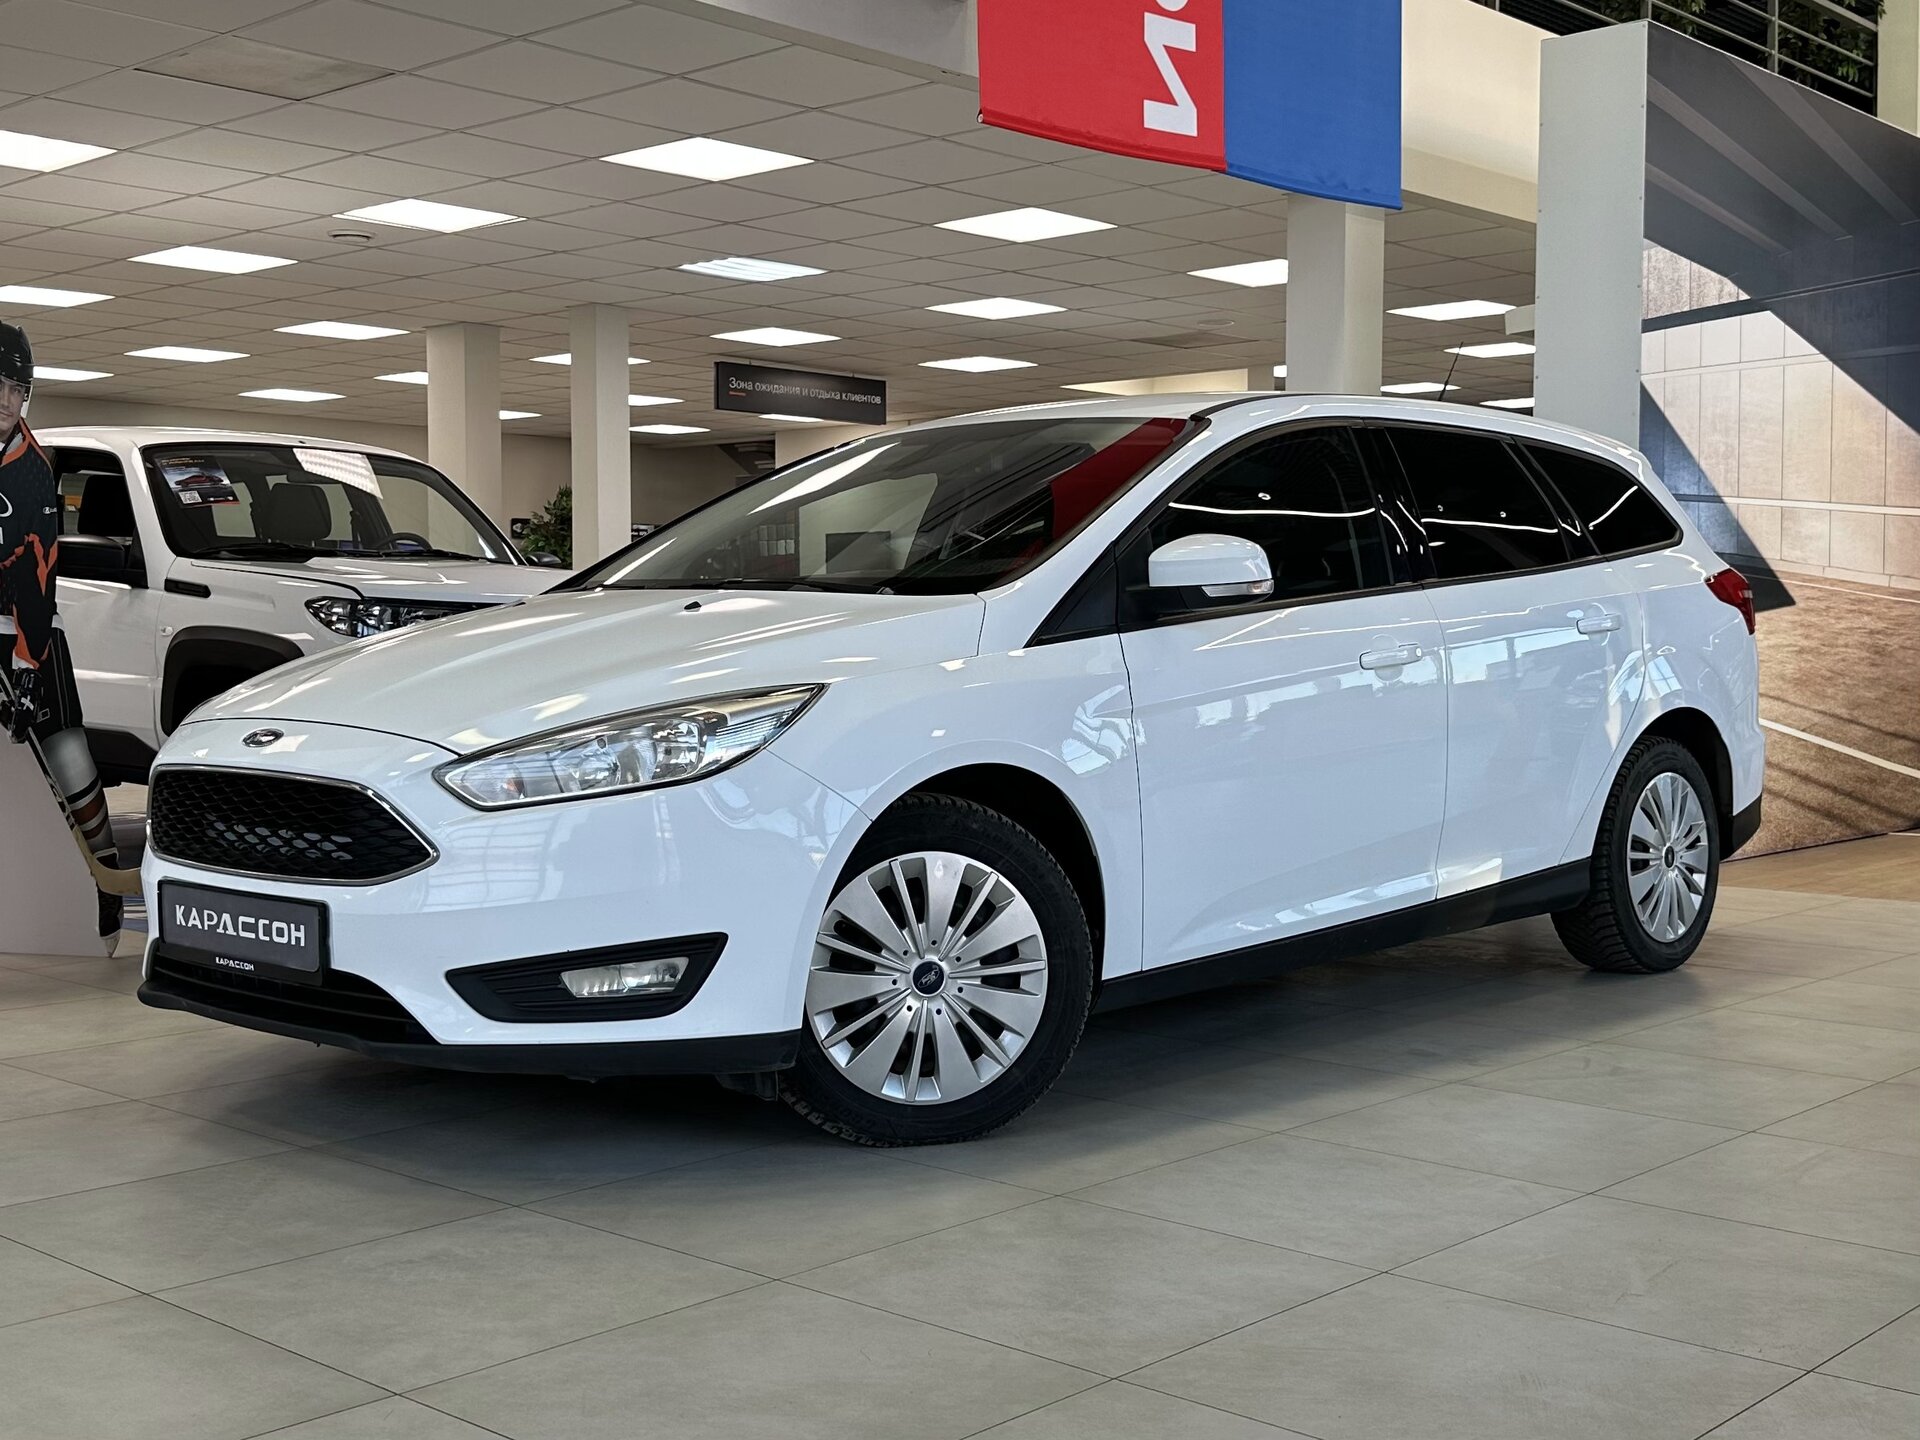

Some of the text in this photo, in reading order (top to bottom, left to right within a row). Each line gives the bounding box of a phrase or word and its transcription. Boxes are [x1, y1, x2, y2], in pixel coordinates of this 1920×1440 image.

[729, 377, 882, 404] Зона ожидания и отдыха клиентов
[175, 904, 306, 946] КАРАССОН
[215, 956, 255, 971] КАРАССОН
